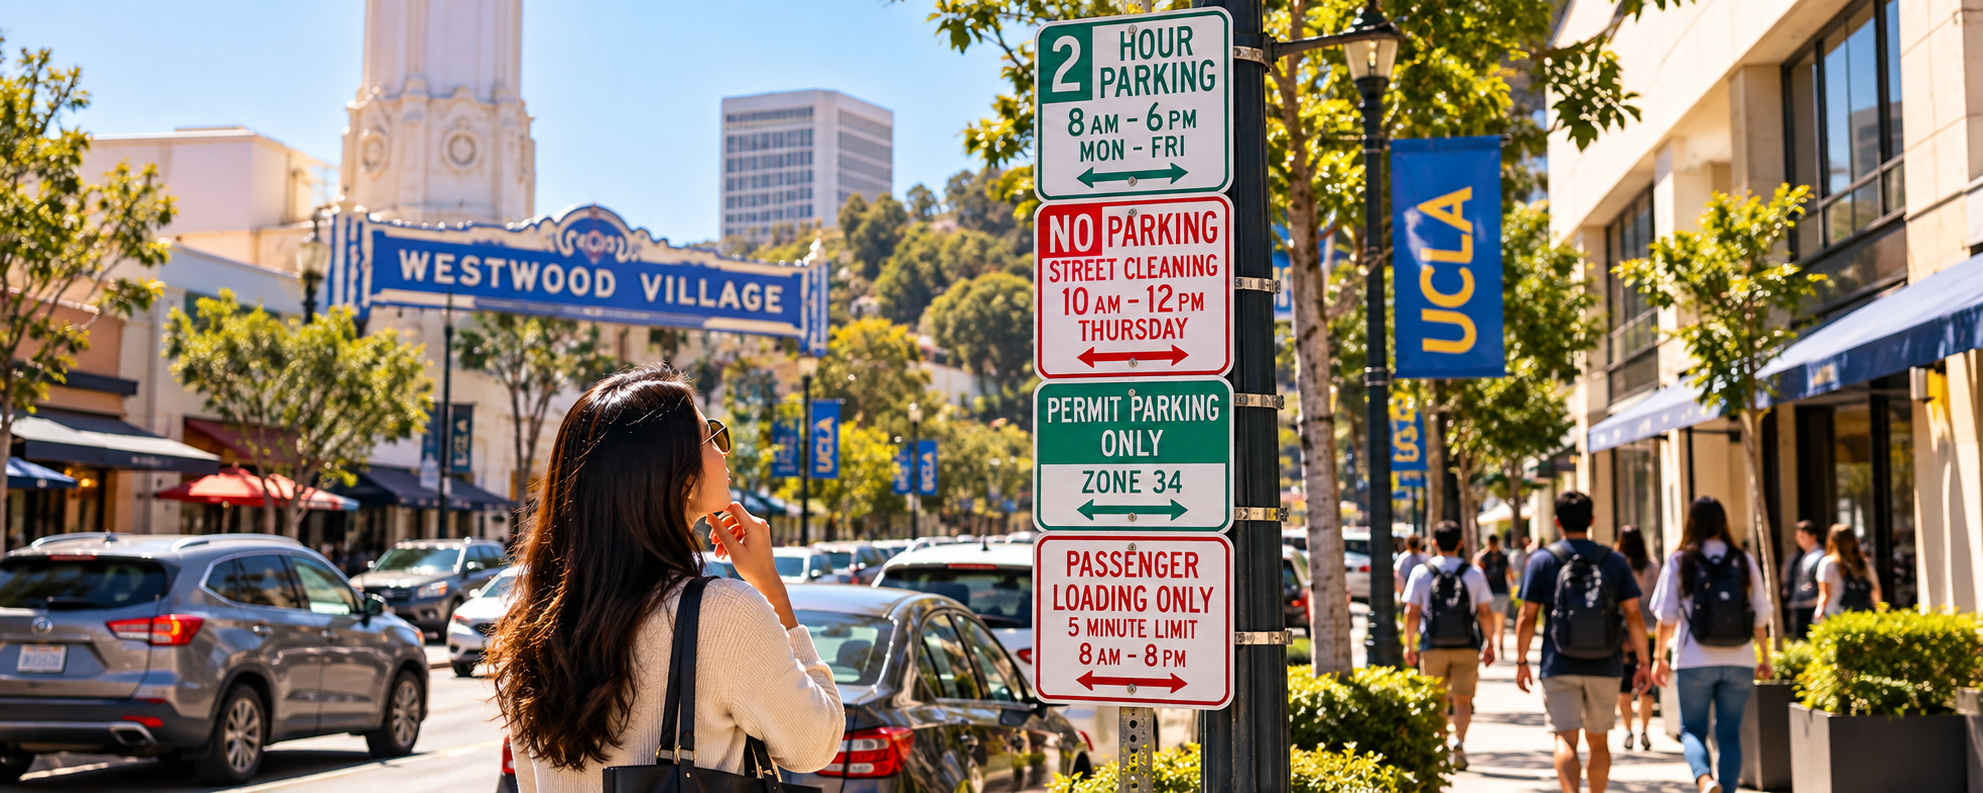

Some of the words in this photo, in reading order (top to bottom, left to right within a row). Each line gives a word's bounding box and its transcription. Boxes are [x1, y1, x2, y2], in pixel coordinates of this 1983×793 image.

[1051, 35, 1081, 93] 2
[1120, 26, 1193, 61] HOUR
[1100, 60, 1216, 98] PARKING
[1067, 107, 1085, 137] 8
[1090, 114, 1119, 134] AM
[1146, 102, 1163, 131] 6
[1168, 109, 1197, 130] PM
[1080, 139, 1124, 162] MON
[1151, 135, 1185, 158] FRI
[1049, 213, 1094, 253] NO
[1107, 210, 1218, 248] PARKING
[397, 247, 617, 299] WESTWOOD
[640, 272, 784, 314] VILLAGE
[1048, 257, 1117, 283] STREET
[1124, 254, 1218, 280] CLEANING
[1417, 186, 1477, 354] UCLA
[1062, 287, 1089, 315] 10
[1094, 294, 1121, 314] AM
[1147, 284, 1173, 313] 12
[1178, 292, 1204, 312] PM
[1078, 317, 1189, 342] THURSDAY
[1047, 396, 1122, 423] PERMIT
[1131, 393, 1220, 422] PARKING
[1101, 429, 1164, 457] ONLY
[1081, 470, 1142, 494] ZONE
[1152, 470, 1183, 494] 34
[1066, 550, 1199, 579] PASSENGER
[1053, 584, 1147, 613] LOADING
[1156, 586, 1214, 614] ONLY
[1068, 616, 1080, 637] 5
[1087, 618, 1147, 638] MINUTE
[1155, 619, 1198, 639] LIMIT
[1078, 642, 1092, 666] 8
[1096, 648, 1121, 666] AM
[1144, 643, 1158, 667] 8
[1163, 650, 1186, 668] PM
